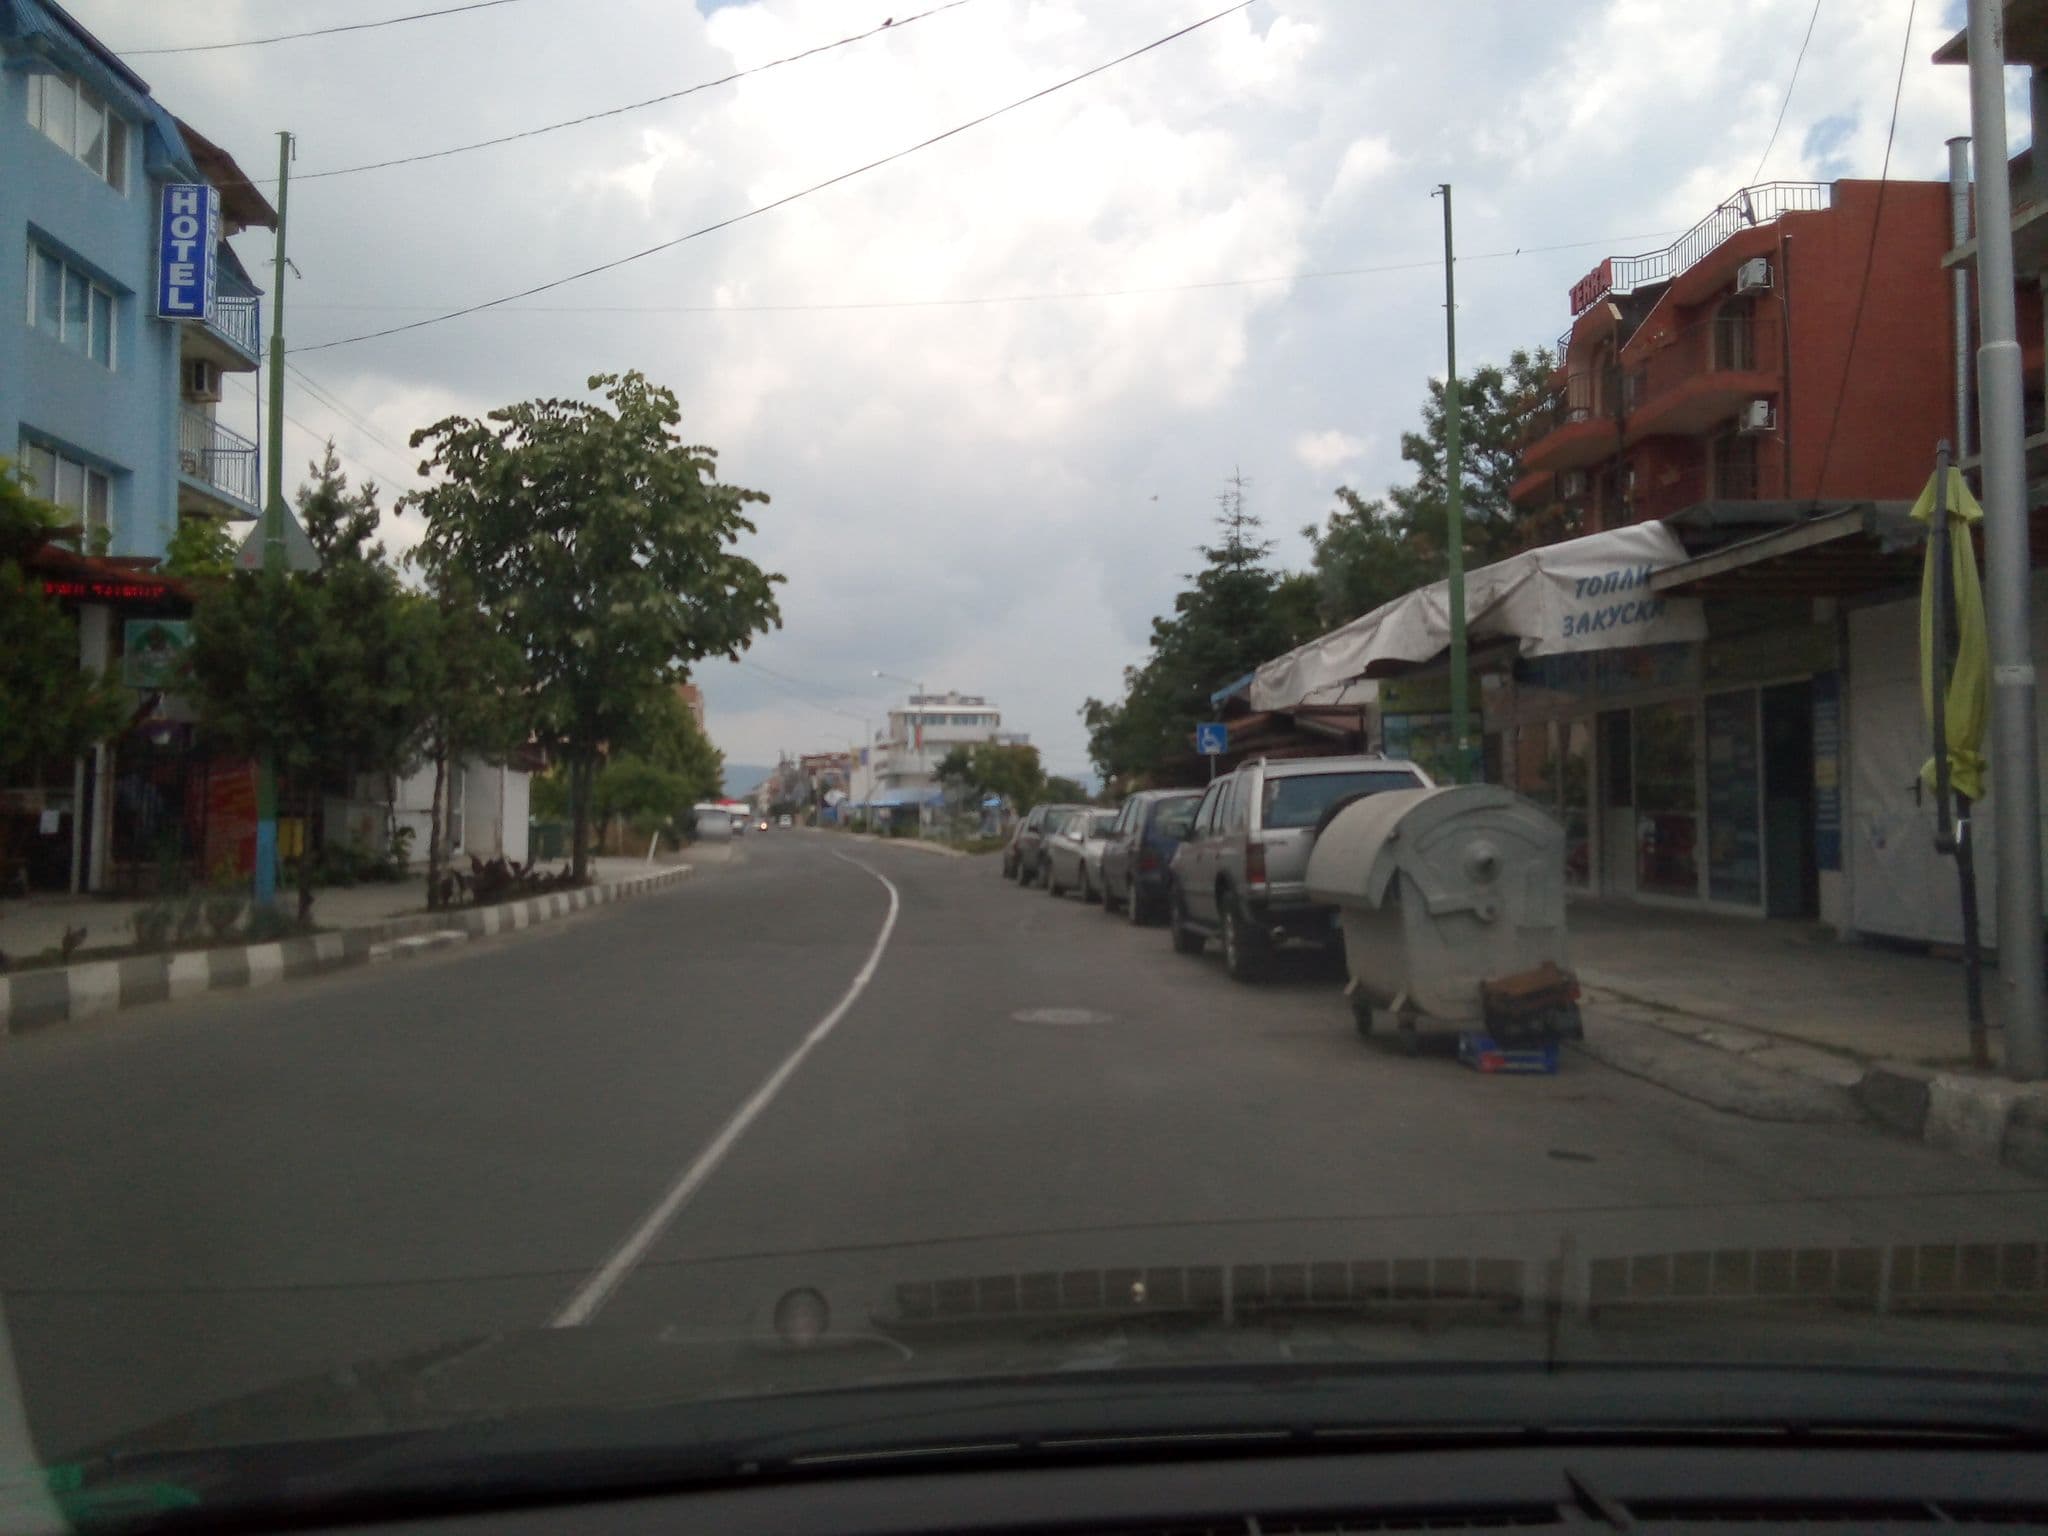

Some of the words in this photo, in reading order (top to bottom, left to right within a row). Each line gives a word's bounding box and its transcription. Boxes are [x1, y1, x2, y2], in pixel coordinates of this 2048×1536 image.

[169, 192, 198, 309] HOTEL
[1576, 564, 1653, 598] ТОПЛИ
[1562, 600, 1665, 637] ЗАКУСКИ
